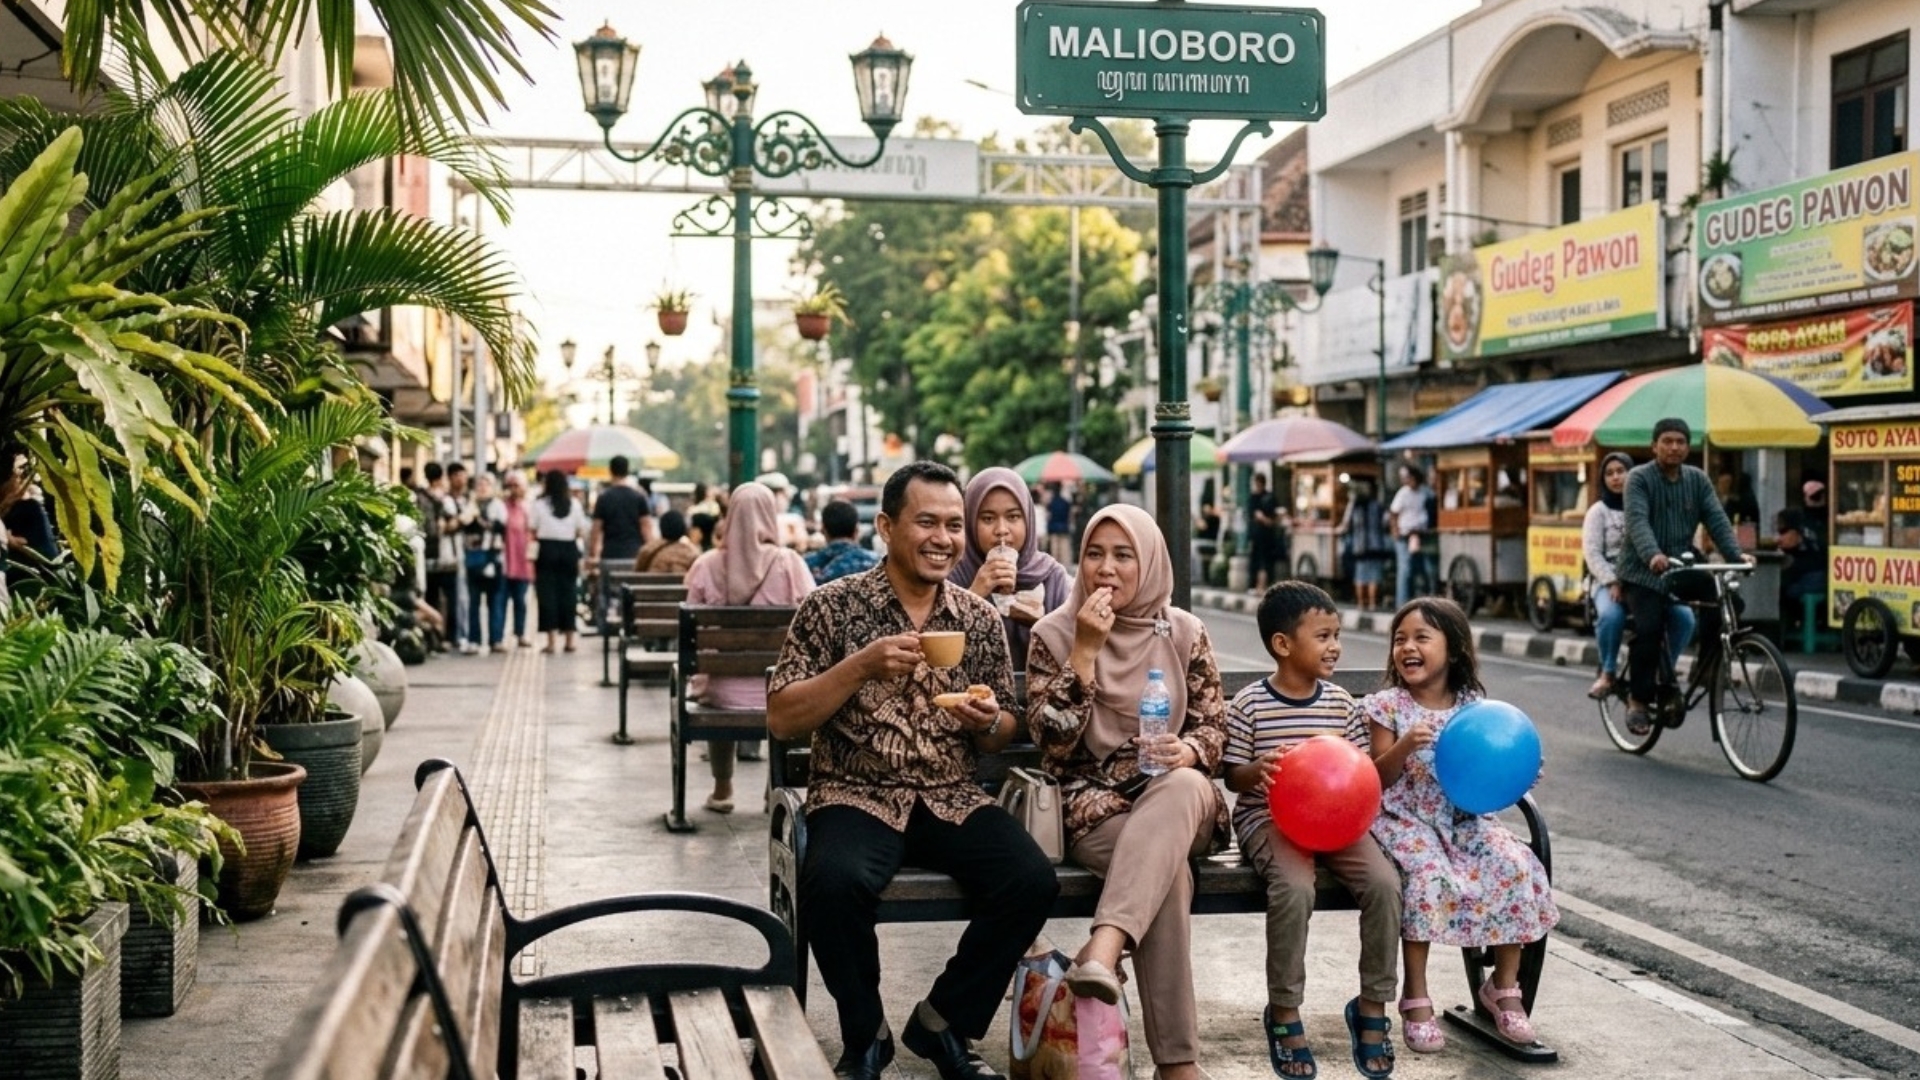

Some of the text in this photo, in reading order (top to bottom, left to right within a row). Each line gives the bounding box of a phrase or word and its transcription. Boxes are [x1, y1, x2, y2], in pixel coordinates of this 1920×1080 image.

[1050, 26, 1296, 64] MALIOBORO
[1706, 168, 1908, 245] GUDEG PAWON
[1491, 233, 1639, 294] Gudeg Pawon
[1834, 426, 1920, 449] SOTO AYA
[1833, 555, 1920, 587] SOTO AYA
